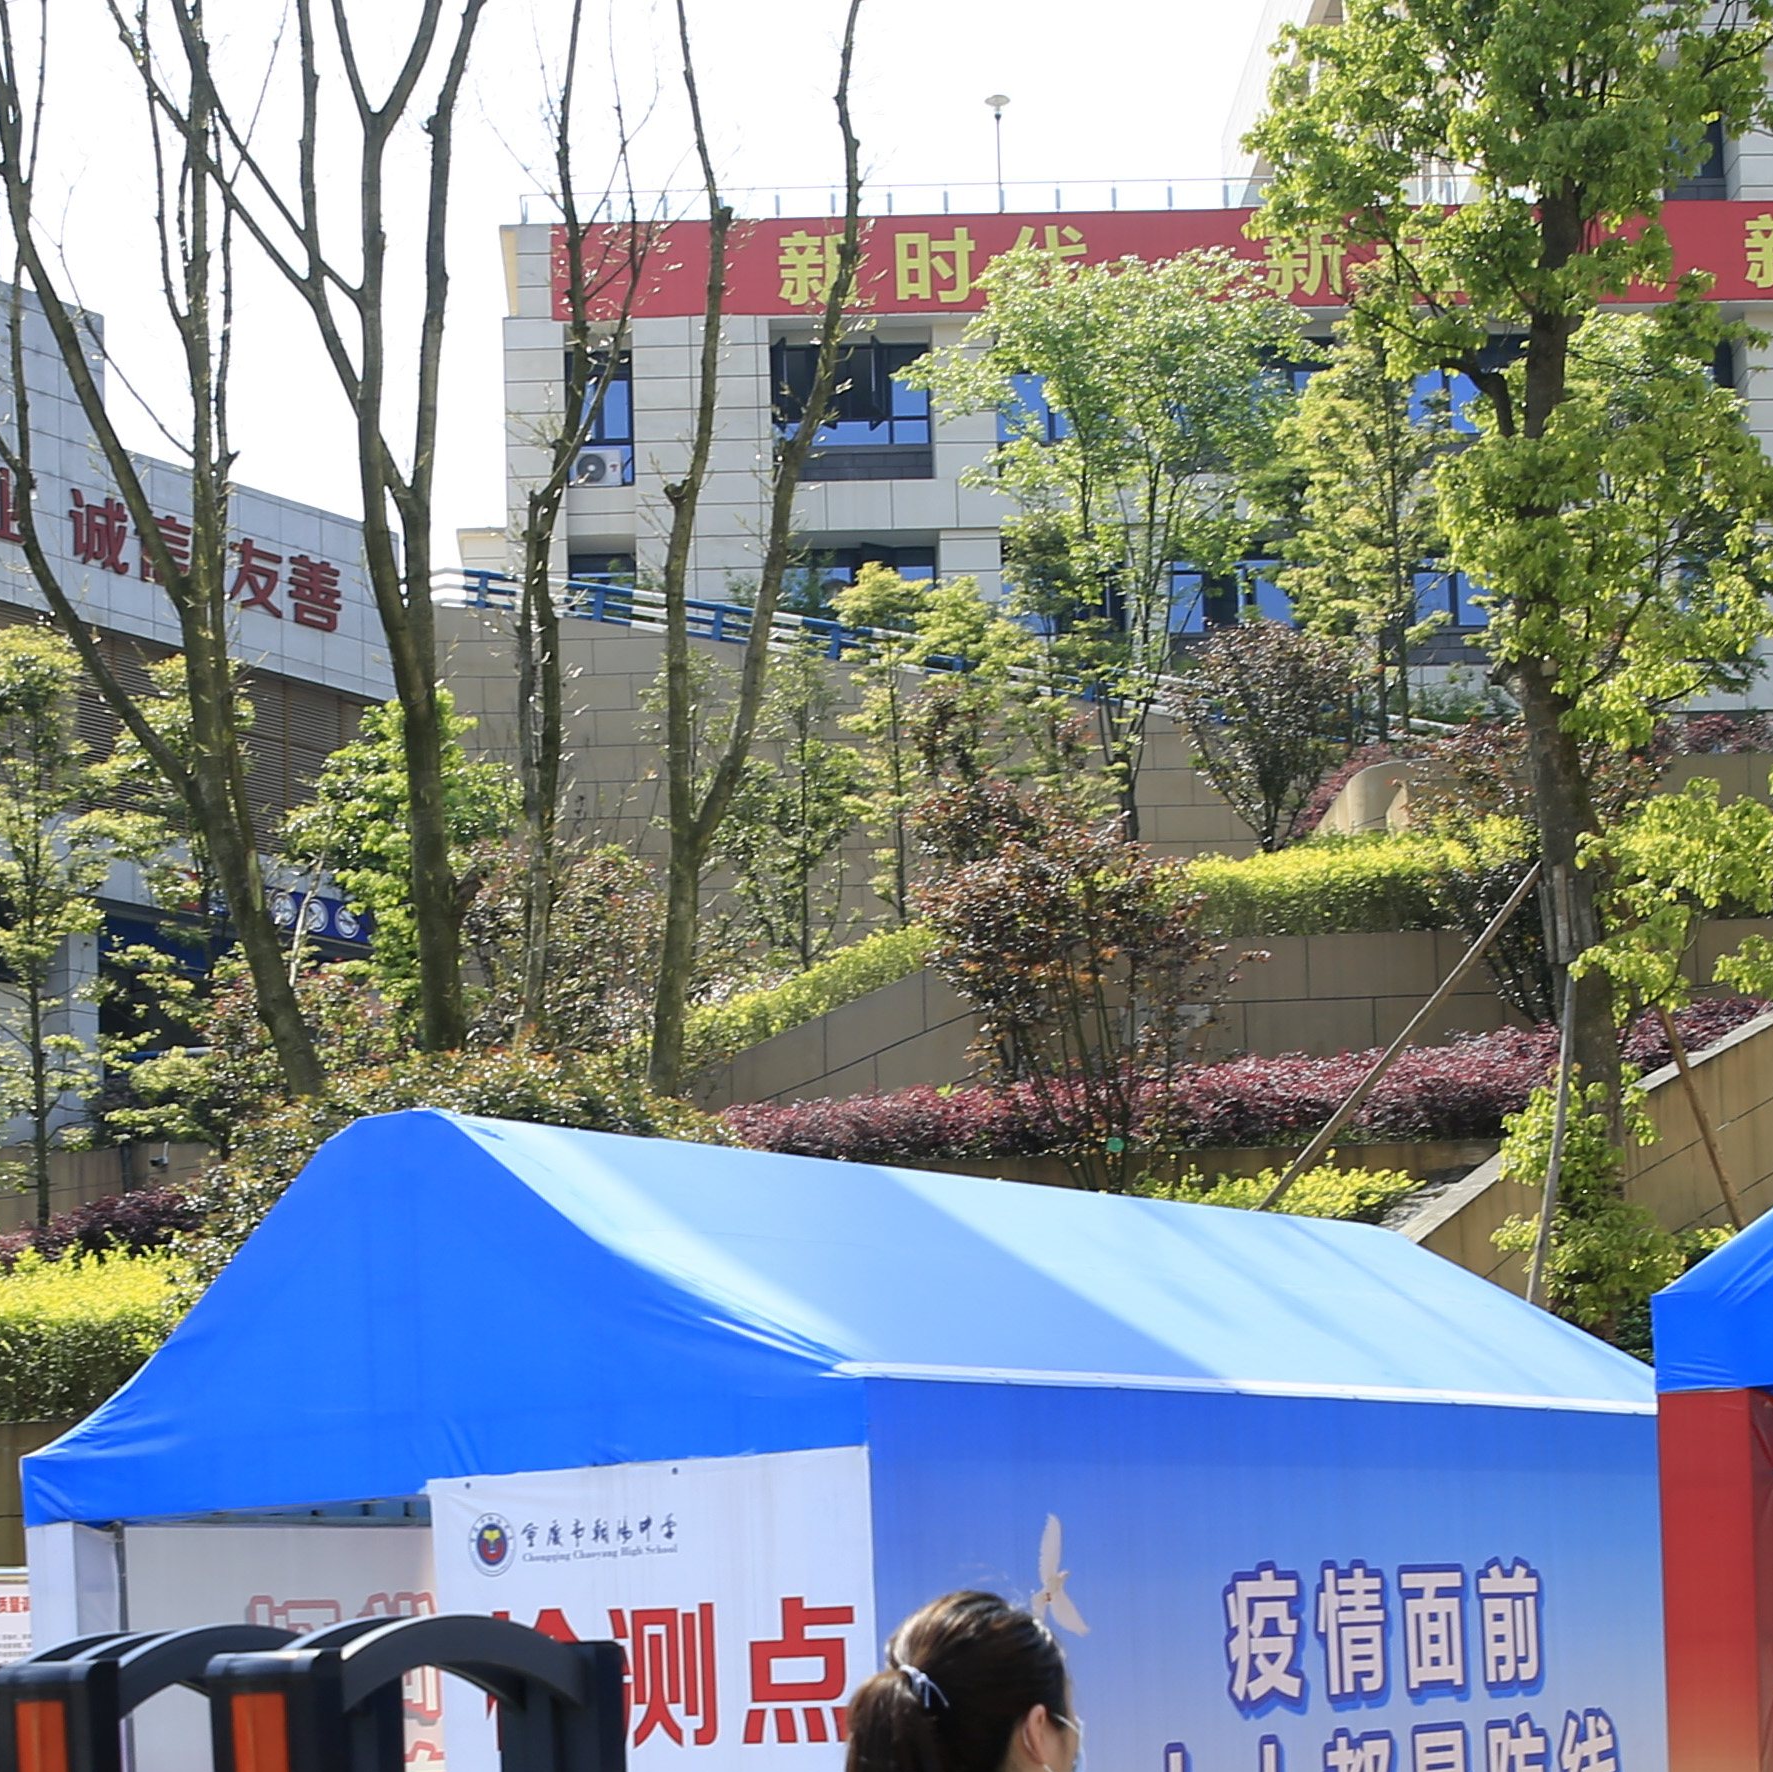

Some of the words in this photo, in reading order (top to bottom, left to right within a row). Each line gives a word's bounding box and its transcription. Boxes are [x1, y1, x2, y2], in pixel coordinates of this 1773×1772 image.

[229, 538, 342, 632] 友善
[485, 1597, 855, 1748] 测点
[1223, 1558, 1543, 1712] 疫情面前
